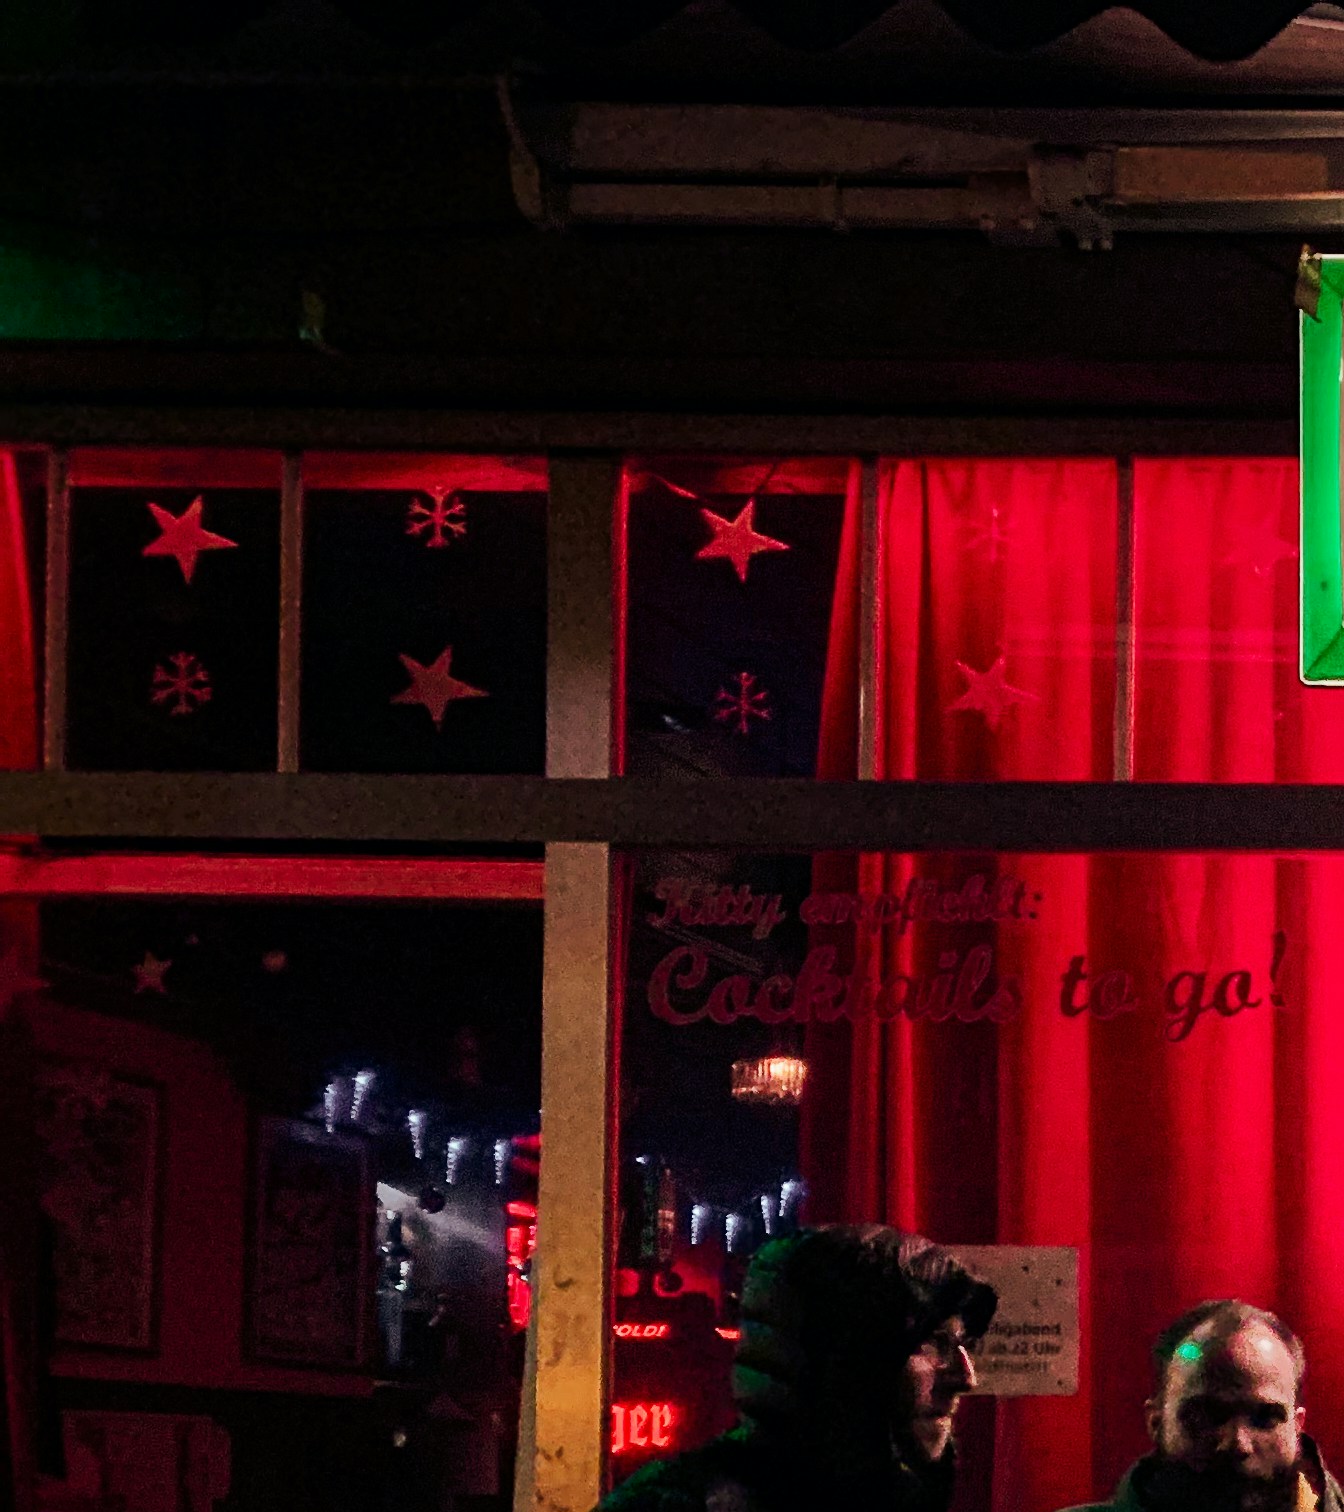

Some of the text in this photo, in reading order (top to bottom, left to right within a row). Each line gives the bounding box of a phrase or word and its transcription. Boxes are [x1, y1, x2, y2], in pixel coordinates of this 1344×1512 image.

[647, 930, 1287, 1043] Cocktails to go!
